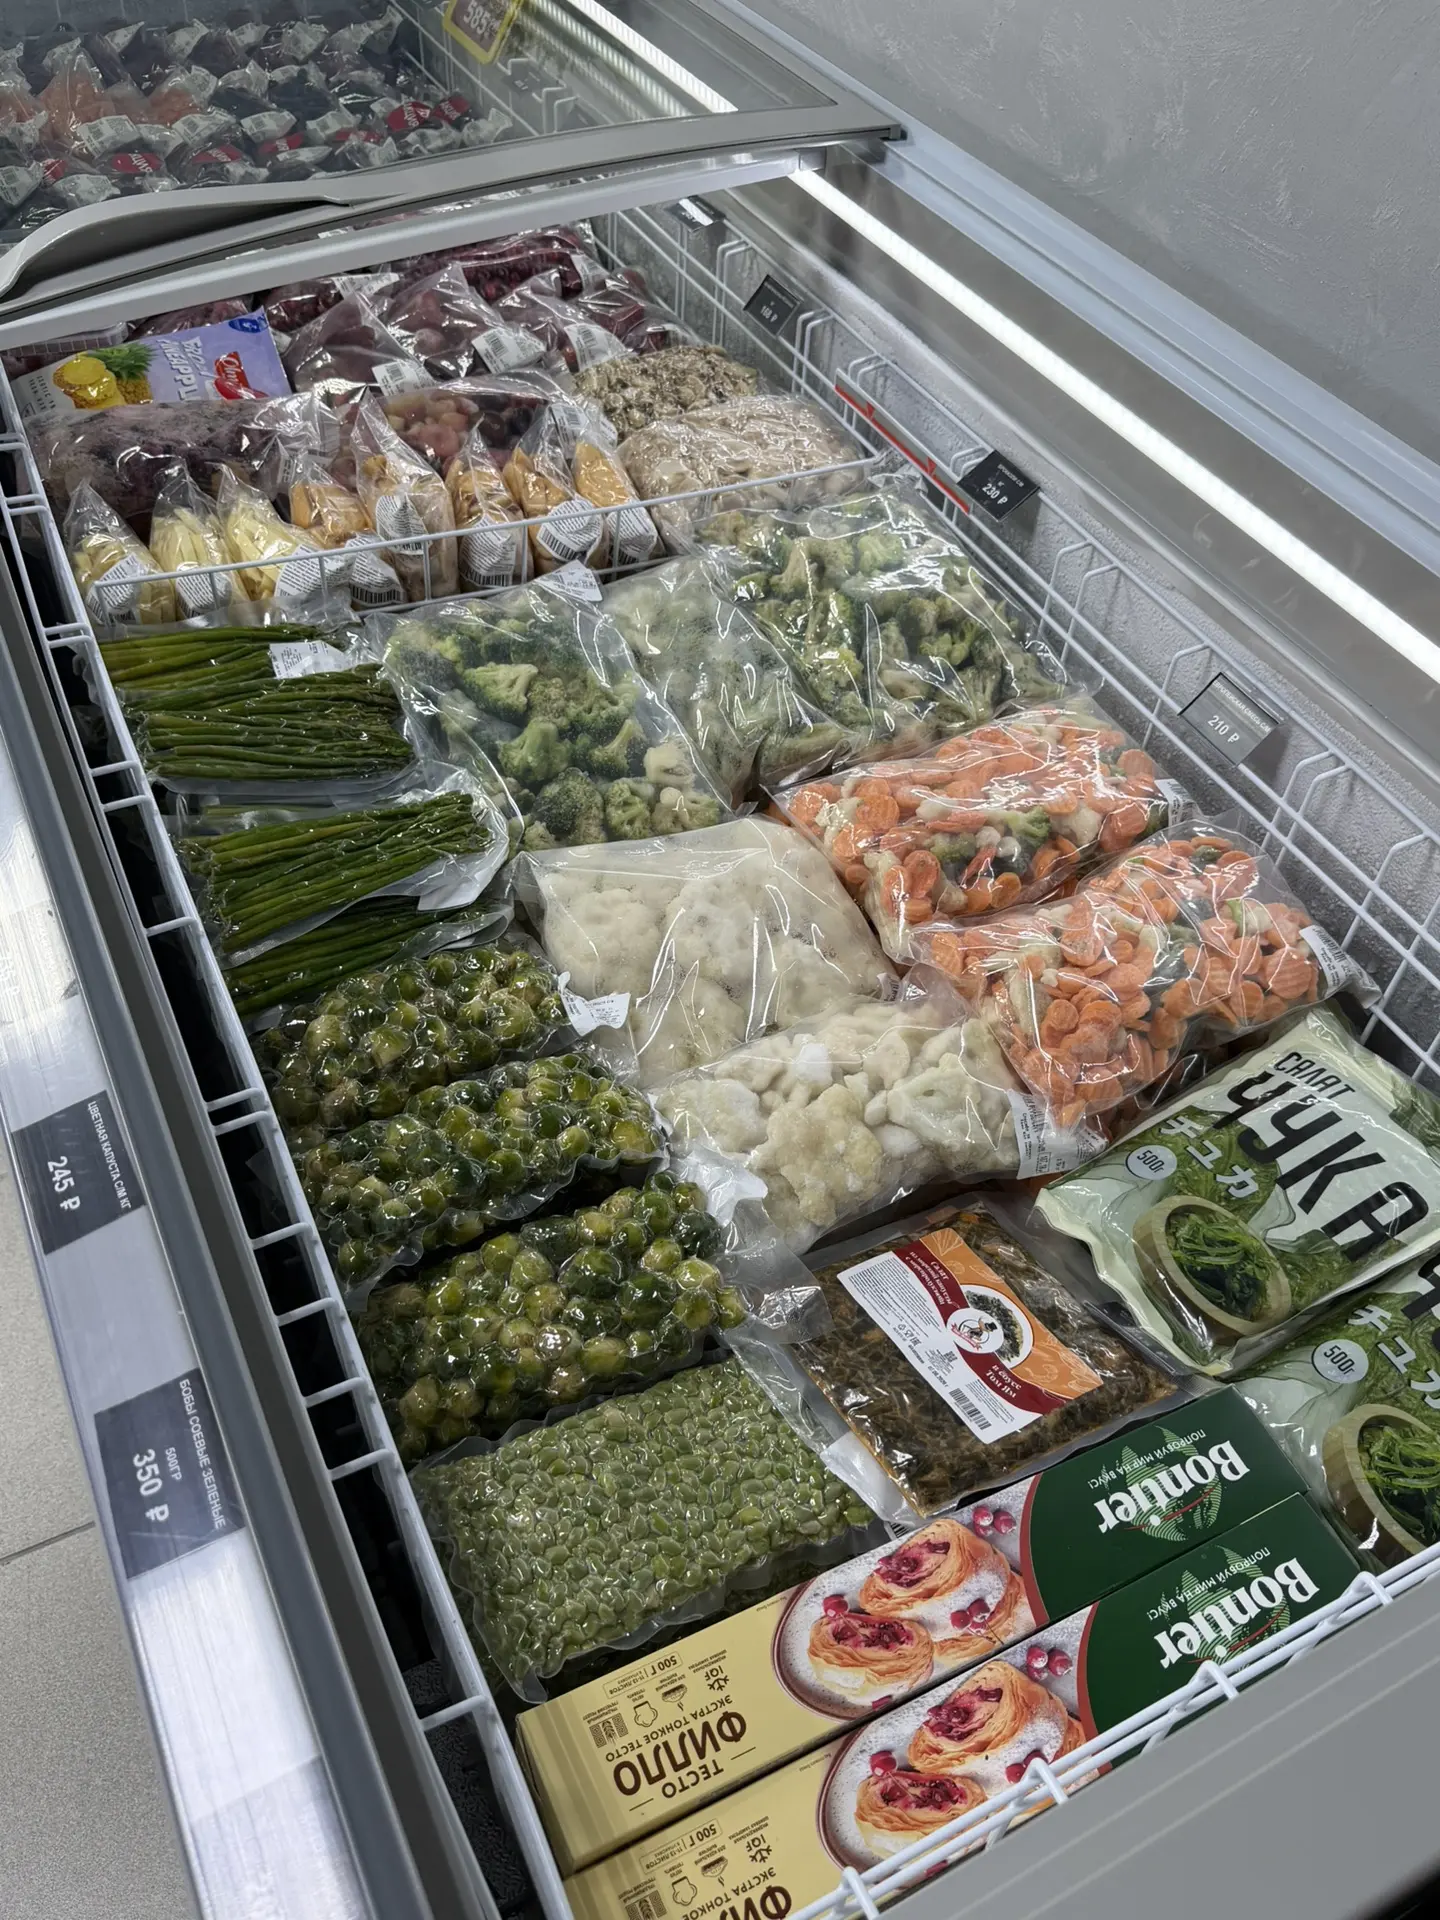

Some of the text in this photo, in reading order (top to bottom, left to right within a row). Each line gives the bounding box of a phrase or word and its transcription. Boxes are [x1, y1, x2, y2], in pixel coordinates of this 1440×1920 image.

[983, 484, 999, 498] 230
[1208, 716, 1239, 742] 210 ₽
[1242, 707, 1261, 725] СМЕСЬ
[1275, 1051, 1356, 1100] САЛАТ
[87, 1100, 132, 1209] ЦВЕТНАЯ КАПУСТА С/М КГ
[1135, 1150, 1165, 1178] 500г
[1158, 1114, 1259, 1198] チュカ
[1212, 1071, 1429, 1262] ЧУКА
[47, 1156, 81, 1212] 245 ₽
[931, 1262, 948, 1279] Салат
[1323, 1345, 1355, 1375] 500г
[986, 1370, 1016, 1397] Том Ям
[165, 1447, 183, 1481] 500ГР
[179, 1378, 227, 1529] БОБЫ СОЕВЫЕ ЗЕЛЕНЫЕ
[1086, 1425, 1206, 1490] ПОПРОБУЙ МИР НА ВКУС!
[133, 1449, 170, 1522] 350 ₽
[1097, 1444, 1246, 1530] Bontier
[1145, 1545, 1272, 1620] ПОПРОБУЙ МИР НА ВКУС!
[1158, 1561, 1315, 1666] Bontier
[652, 1656, 676, 1675] 500 Г
[705, 1666, 723, 1680] IQF
[609, 1678, 631, 1694] ЛИСТОВ
[606, 1695, 732, 1762] ЭКСТРА ТОНКОЕ ТЕСТО
[614, 1712, 745, 1794] ФИЛЛО
[662, 1760, 722, 1798] ТЕСТО
[690, 1824, 716, 1846] 500 Г
[746, 1834, 765, 1851] IQF
[646, 1854, 669, 1869] ЛИСТОВ
[732, 1868, 775, 1895] ЭКСТРА
[683, 1894, 730, 1920] ТОНКОЕ
